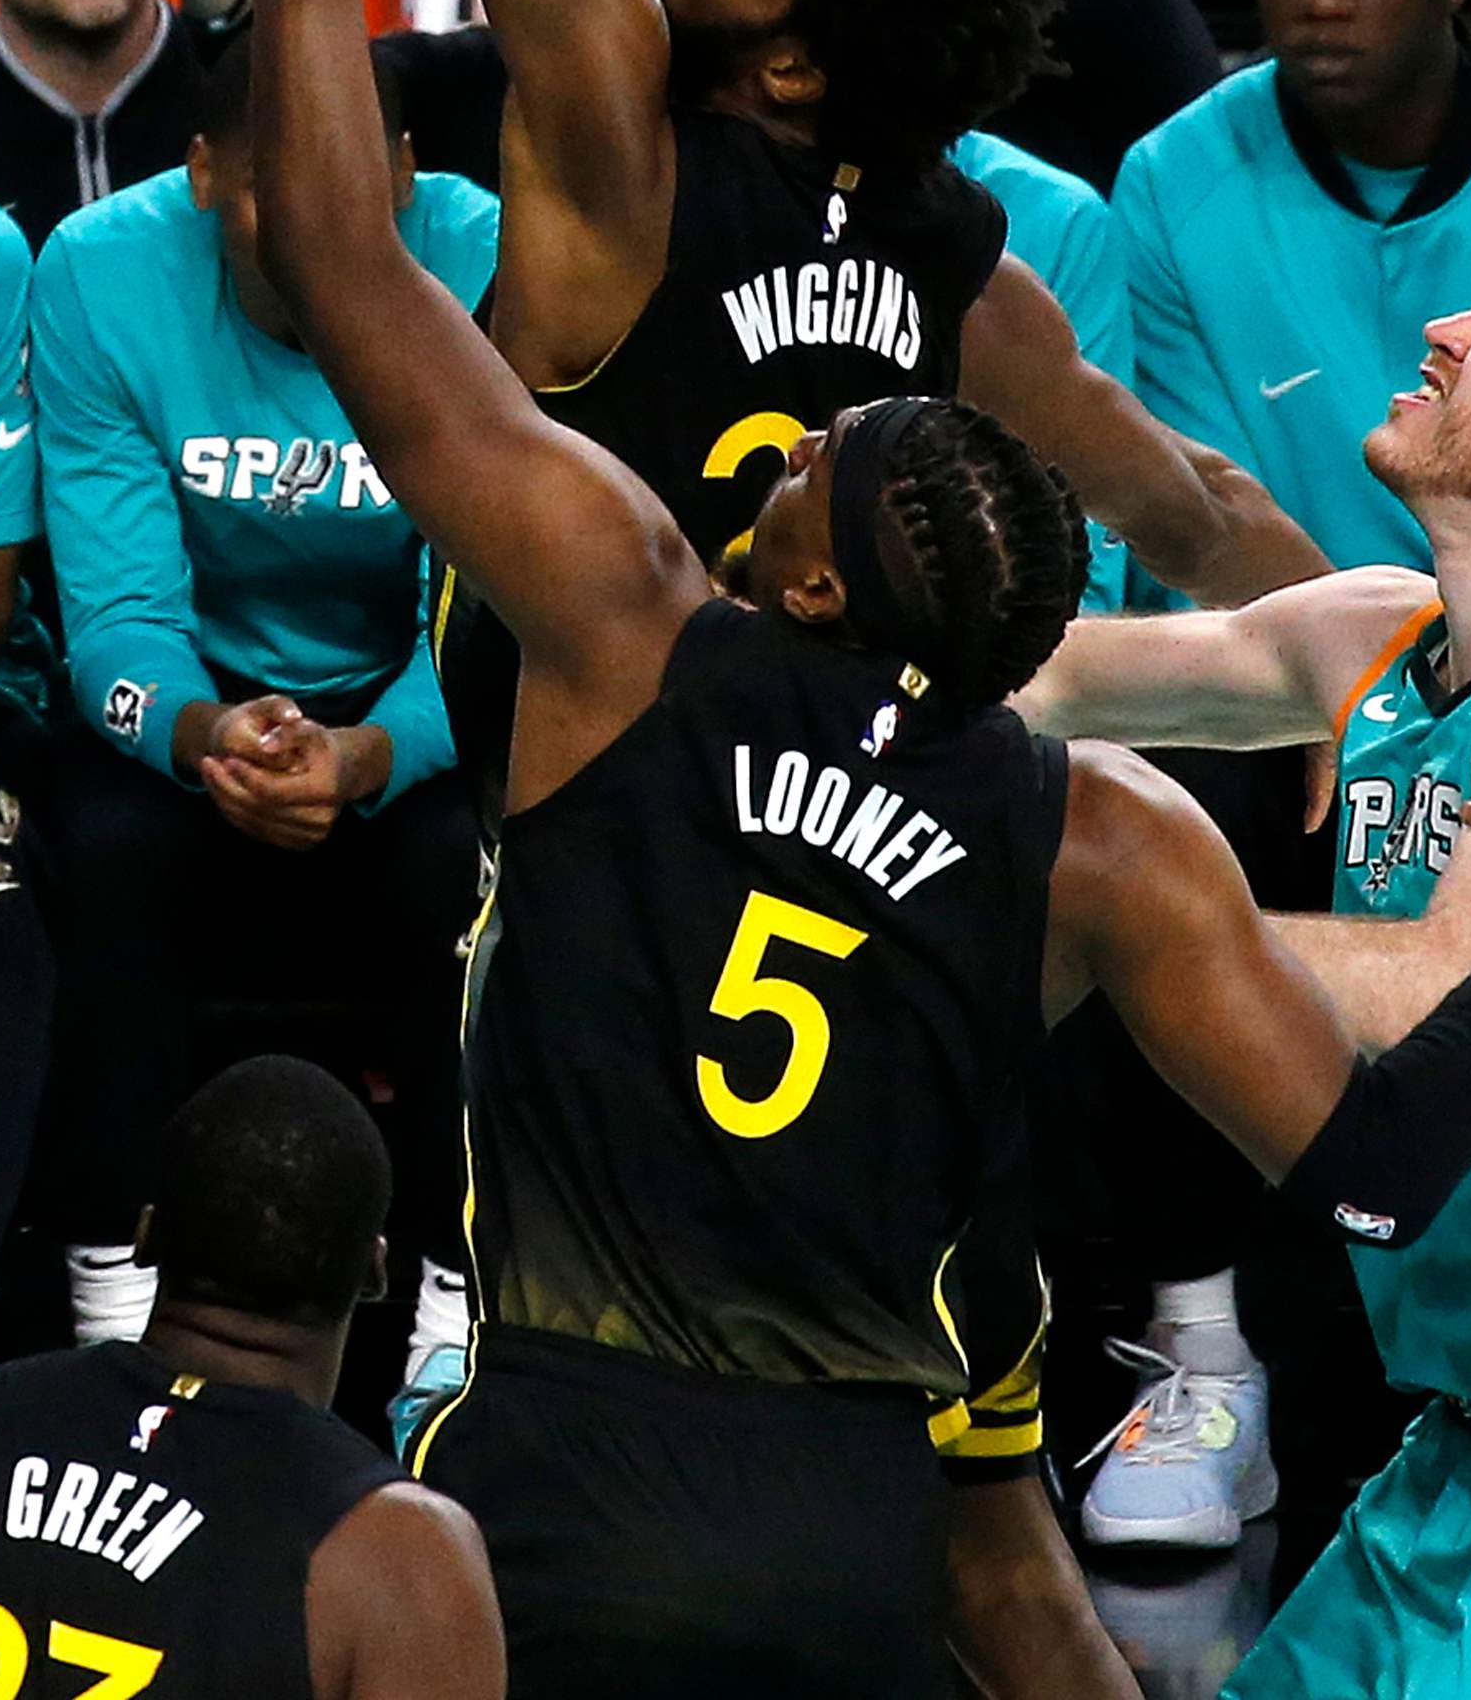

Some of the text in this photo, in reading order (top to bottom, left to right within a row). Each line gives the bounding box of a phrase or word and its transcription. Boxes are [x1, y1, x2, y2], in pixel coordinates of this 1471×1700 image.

[722, 258, 923, 371] WIGGINS
[180, 434, 397, 517] SPUR
[733, 744, 967, 902] LOONEY
[696, 889, 870, 1138] 5
[5, 1456, 207, 1583] GREEN
